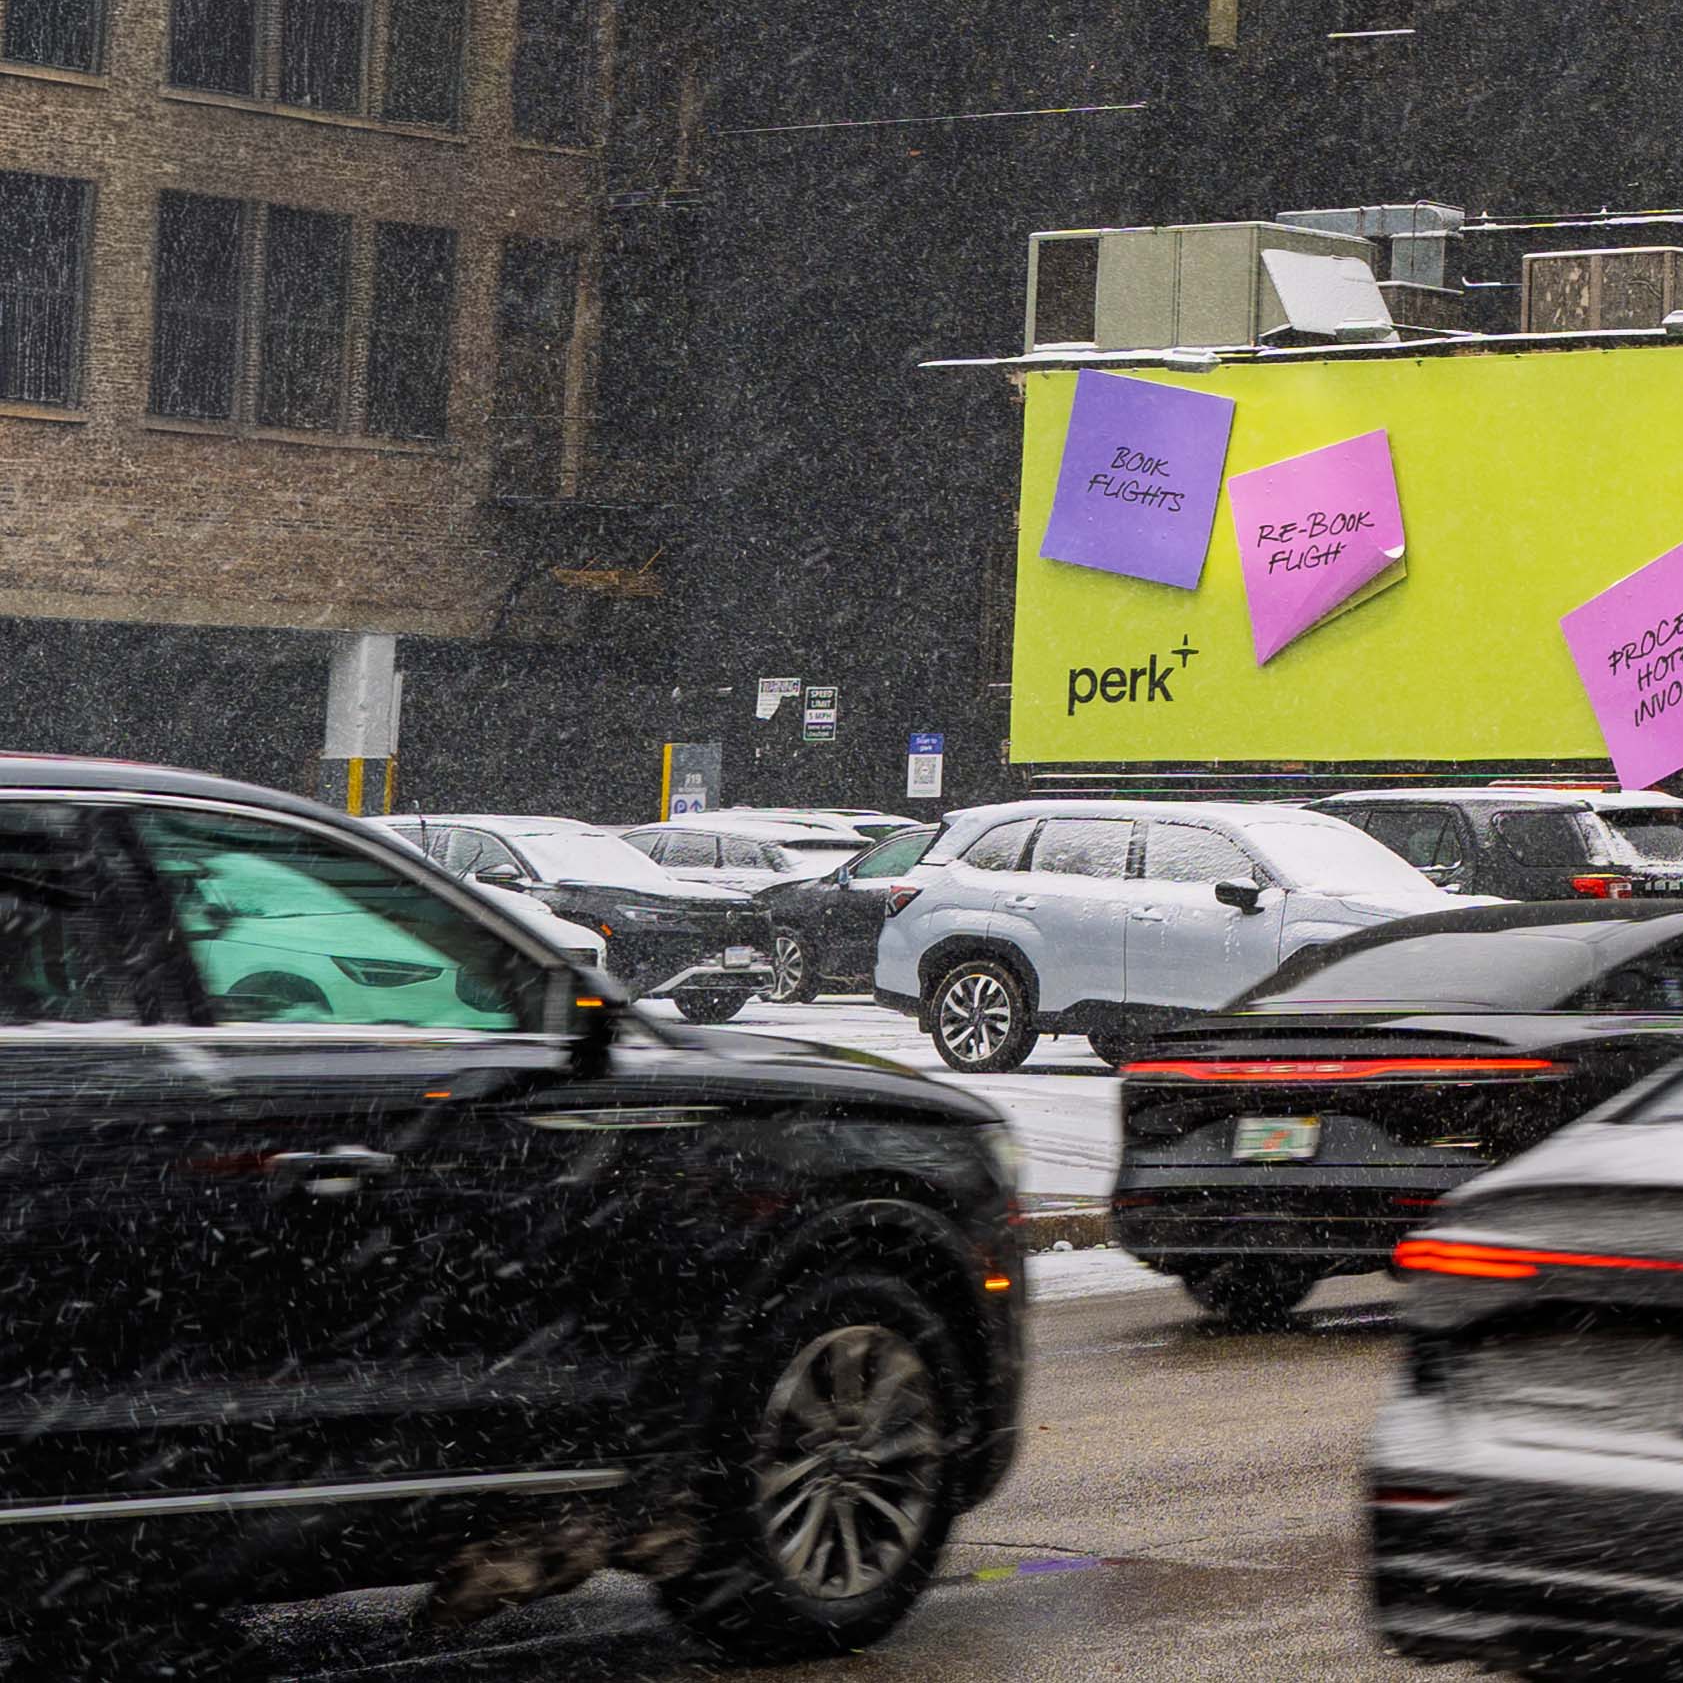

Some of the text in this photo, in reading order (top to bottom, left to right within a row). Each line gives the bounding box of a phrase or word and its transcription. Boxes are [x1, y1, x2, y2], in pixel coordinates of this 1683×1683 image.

[1111, 447, 1169, 477] BOOK
[1088, 474, 1186, 513] FLIGHTS
[1257, 511, 1375, 548] RE-BOOK
[1269, 541, 1347, 575] FLIGH
[1067, 654, 1174, 716] perk
